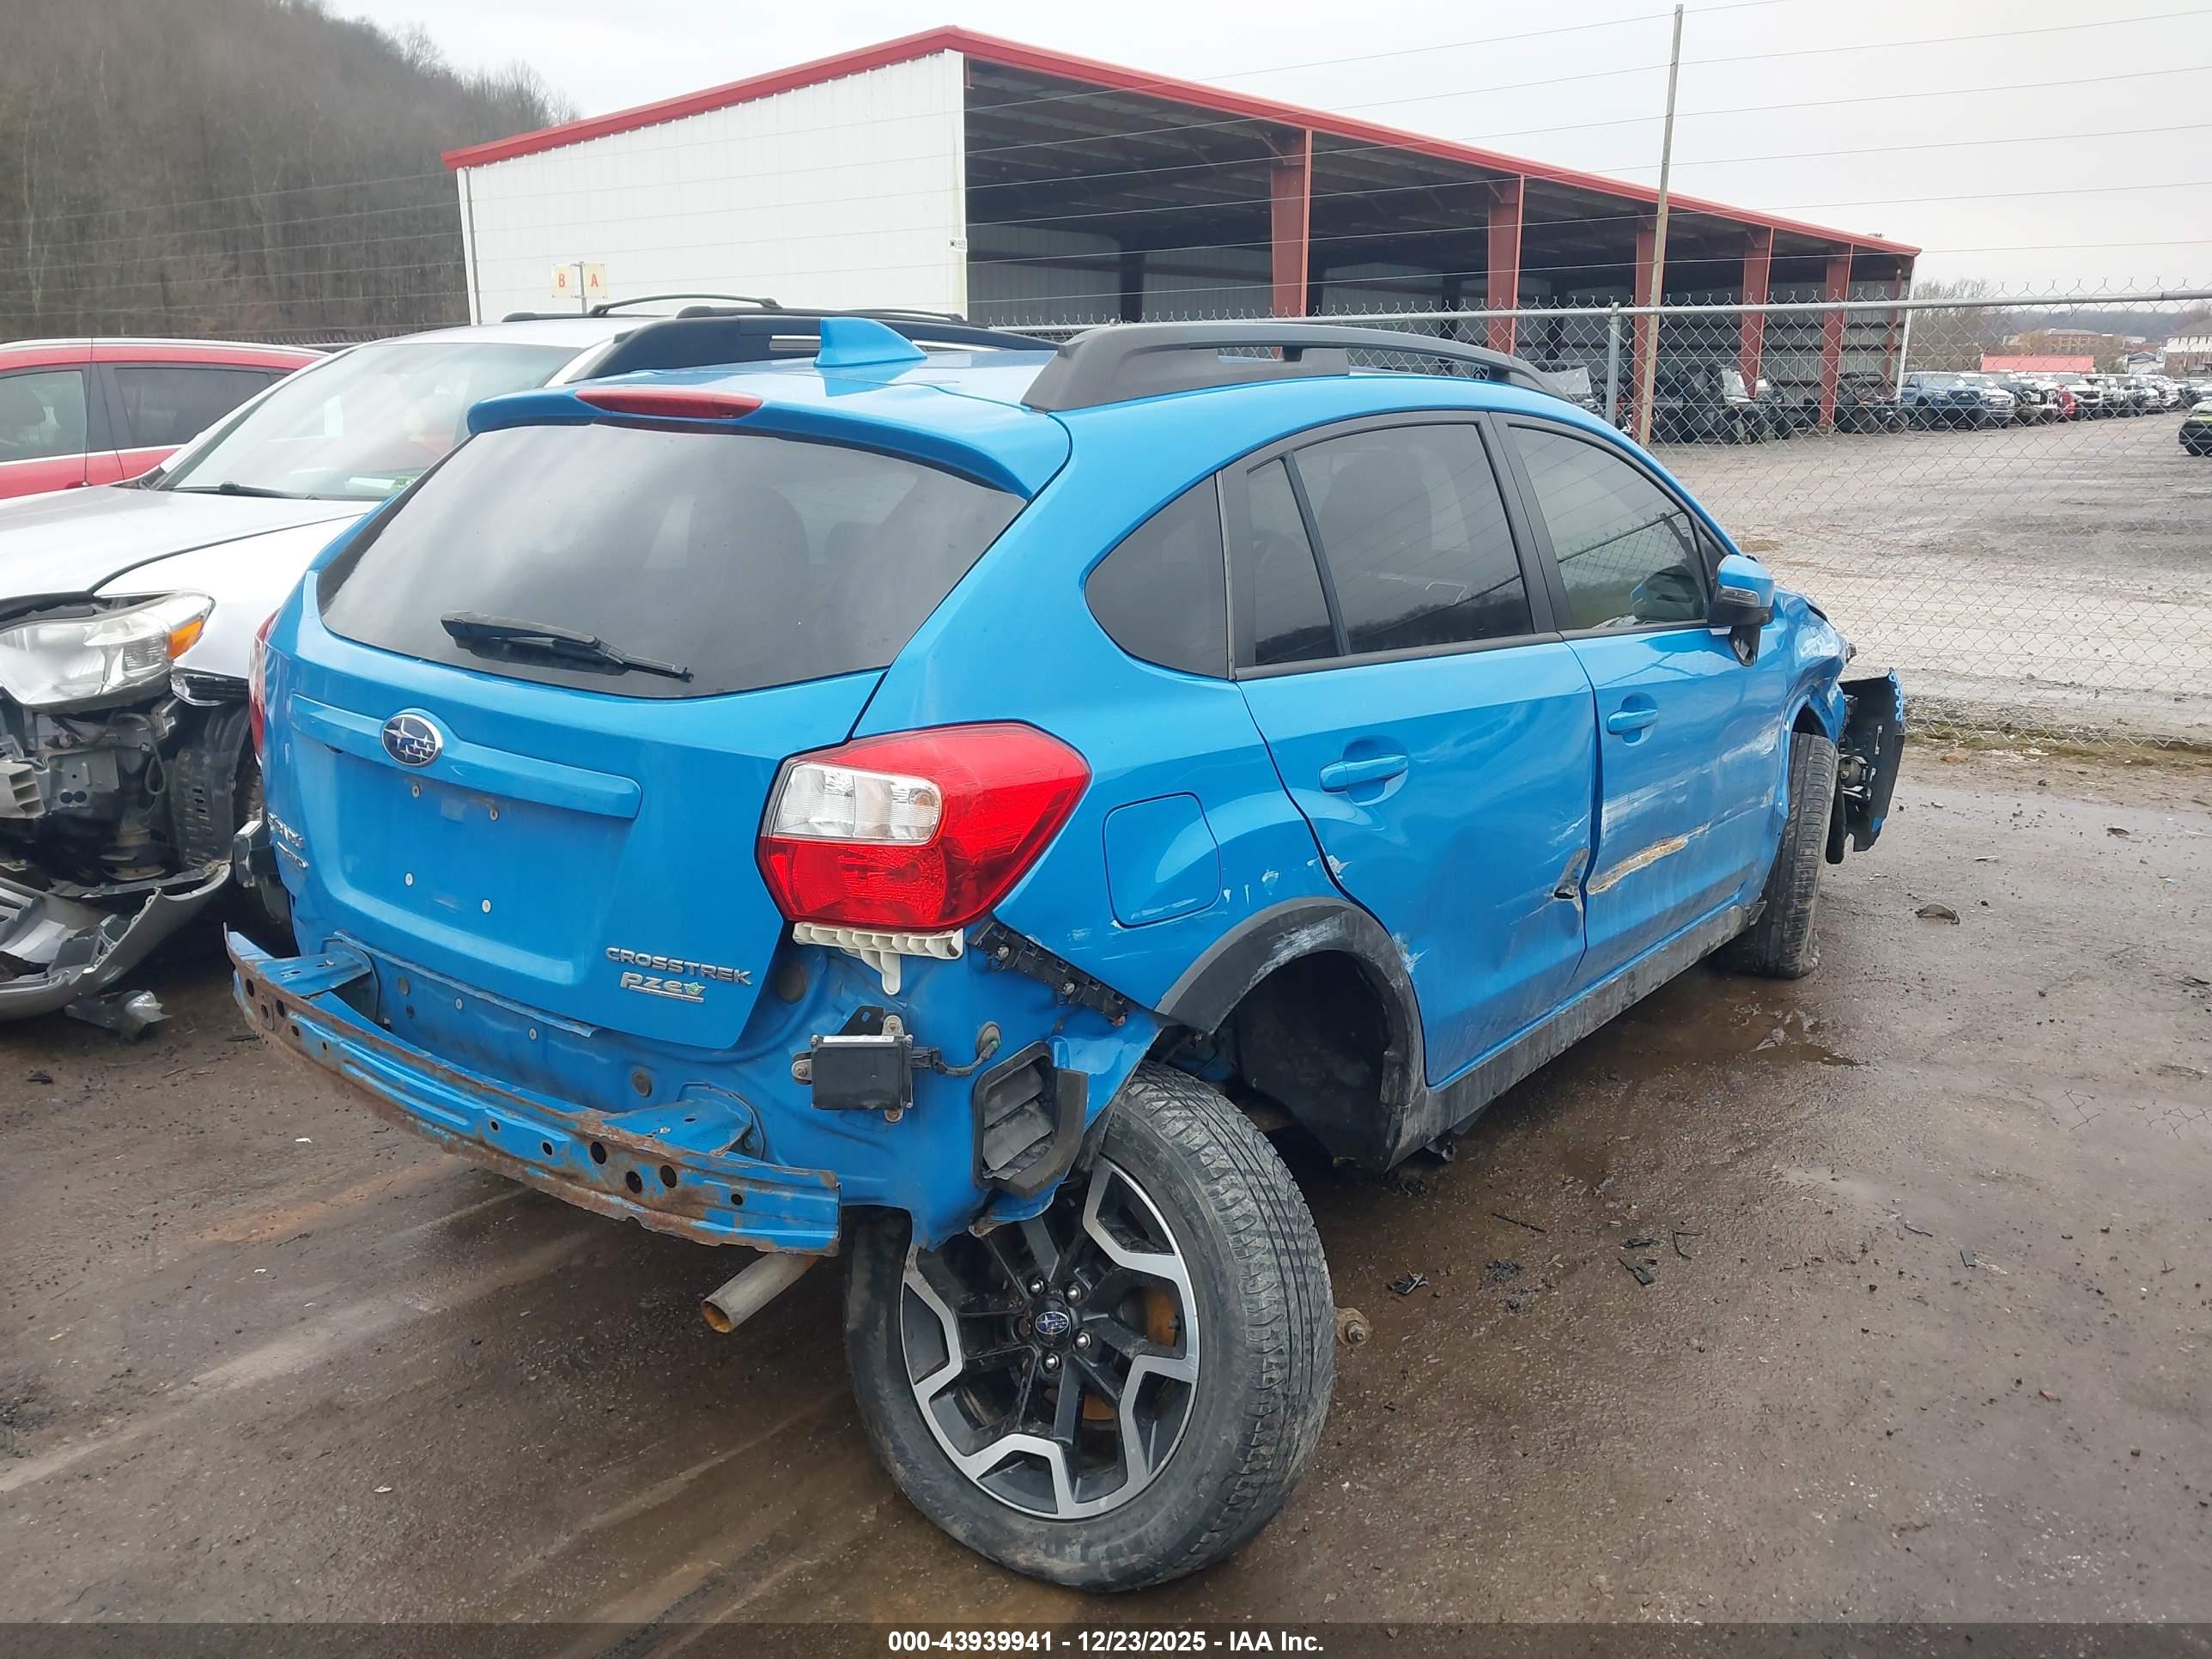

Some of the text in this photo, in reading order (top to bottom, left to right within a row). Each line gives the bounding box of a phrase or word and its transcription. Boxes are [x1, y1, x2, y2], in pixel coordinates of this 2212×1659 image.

[558, 273, 566, 288] B
[591, 273, 599, 288] A
[605, 946, 752, 986] CROSSTREK
